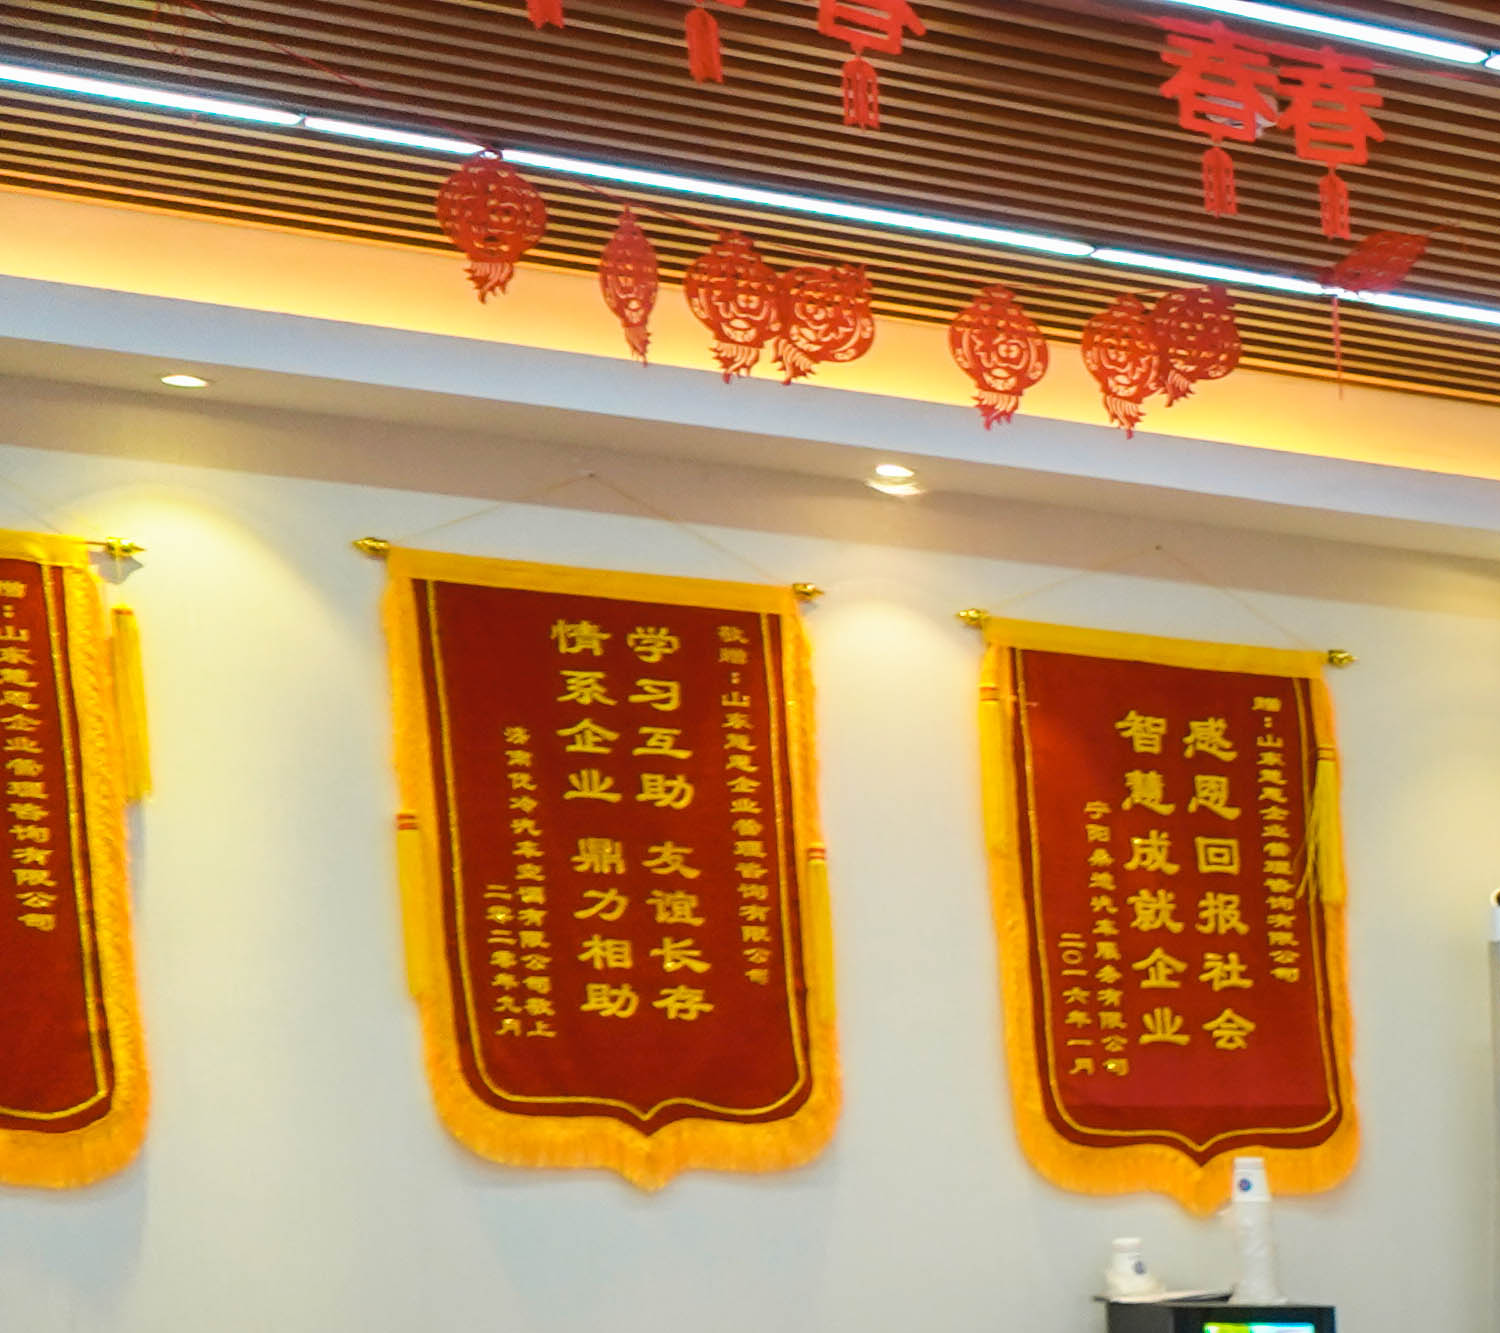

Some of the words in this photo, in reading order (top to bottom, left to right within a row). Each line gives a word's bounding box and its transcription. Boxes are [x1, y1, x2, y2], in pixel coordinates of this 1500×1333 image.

[550, 618, 623, 803] 情系企业
[626, 626, 695, 810] 学习互助
[570, 836, 640, 1019] 鼎力相助
[641, 840, 715, 1021] 友谊长存
[1114, 710, 1191, 1046] 智慧成就企业
[1182, 716, 1256, 1050] 感恩回报社会
